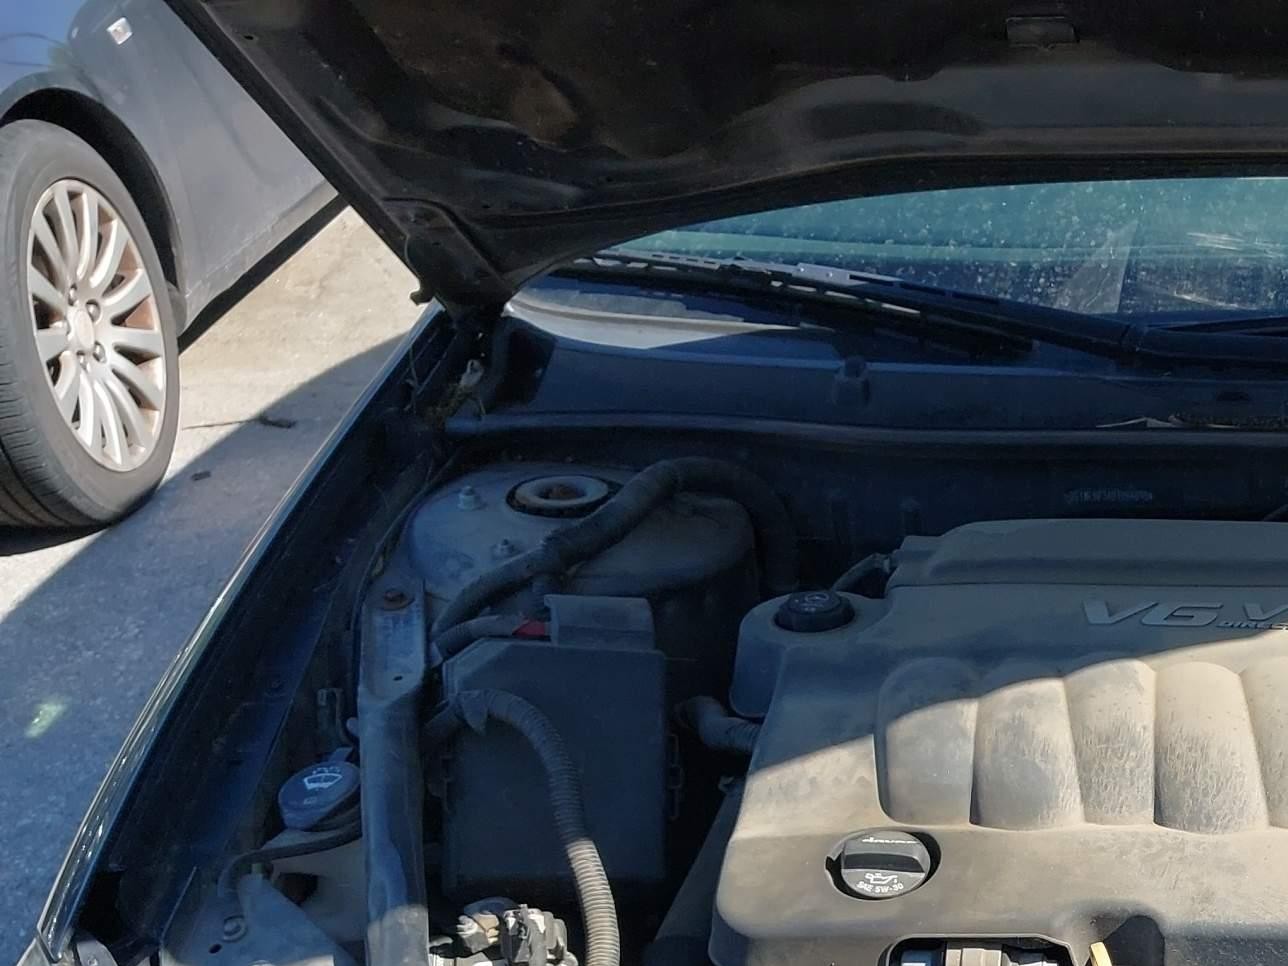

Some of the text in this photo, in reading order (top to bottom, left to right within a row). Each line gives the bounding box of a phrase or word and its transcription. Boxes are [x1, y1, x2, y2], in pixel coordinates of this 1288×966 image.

[1083, 600, 1223, 627] V6
[857, 881, 904, 893] SAE 5W-30
